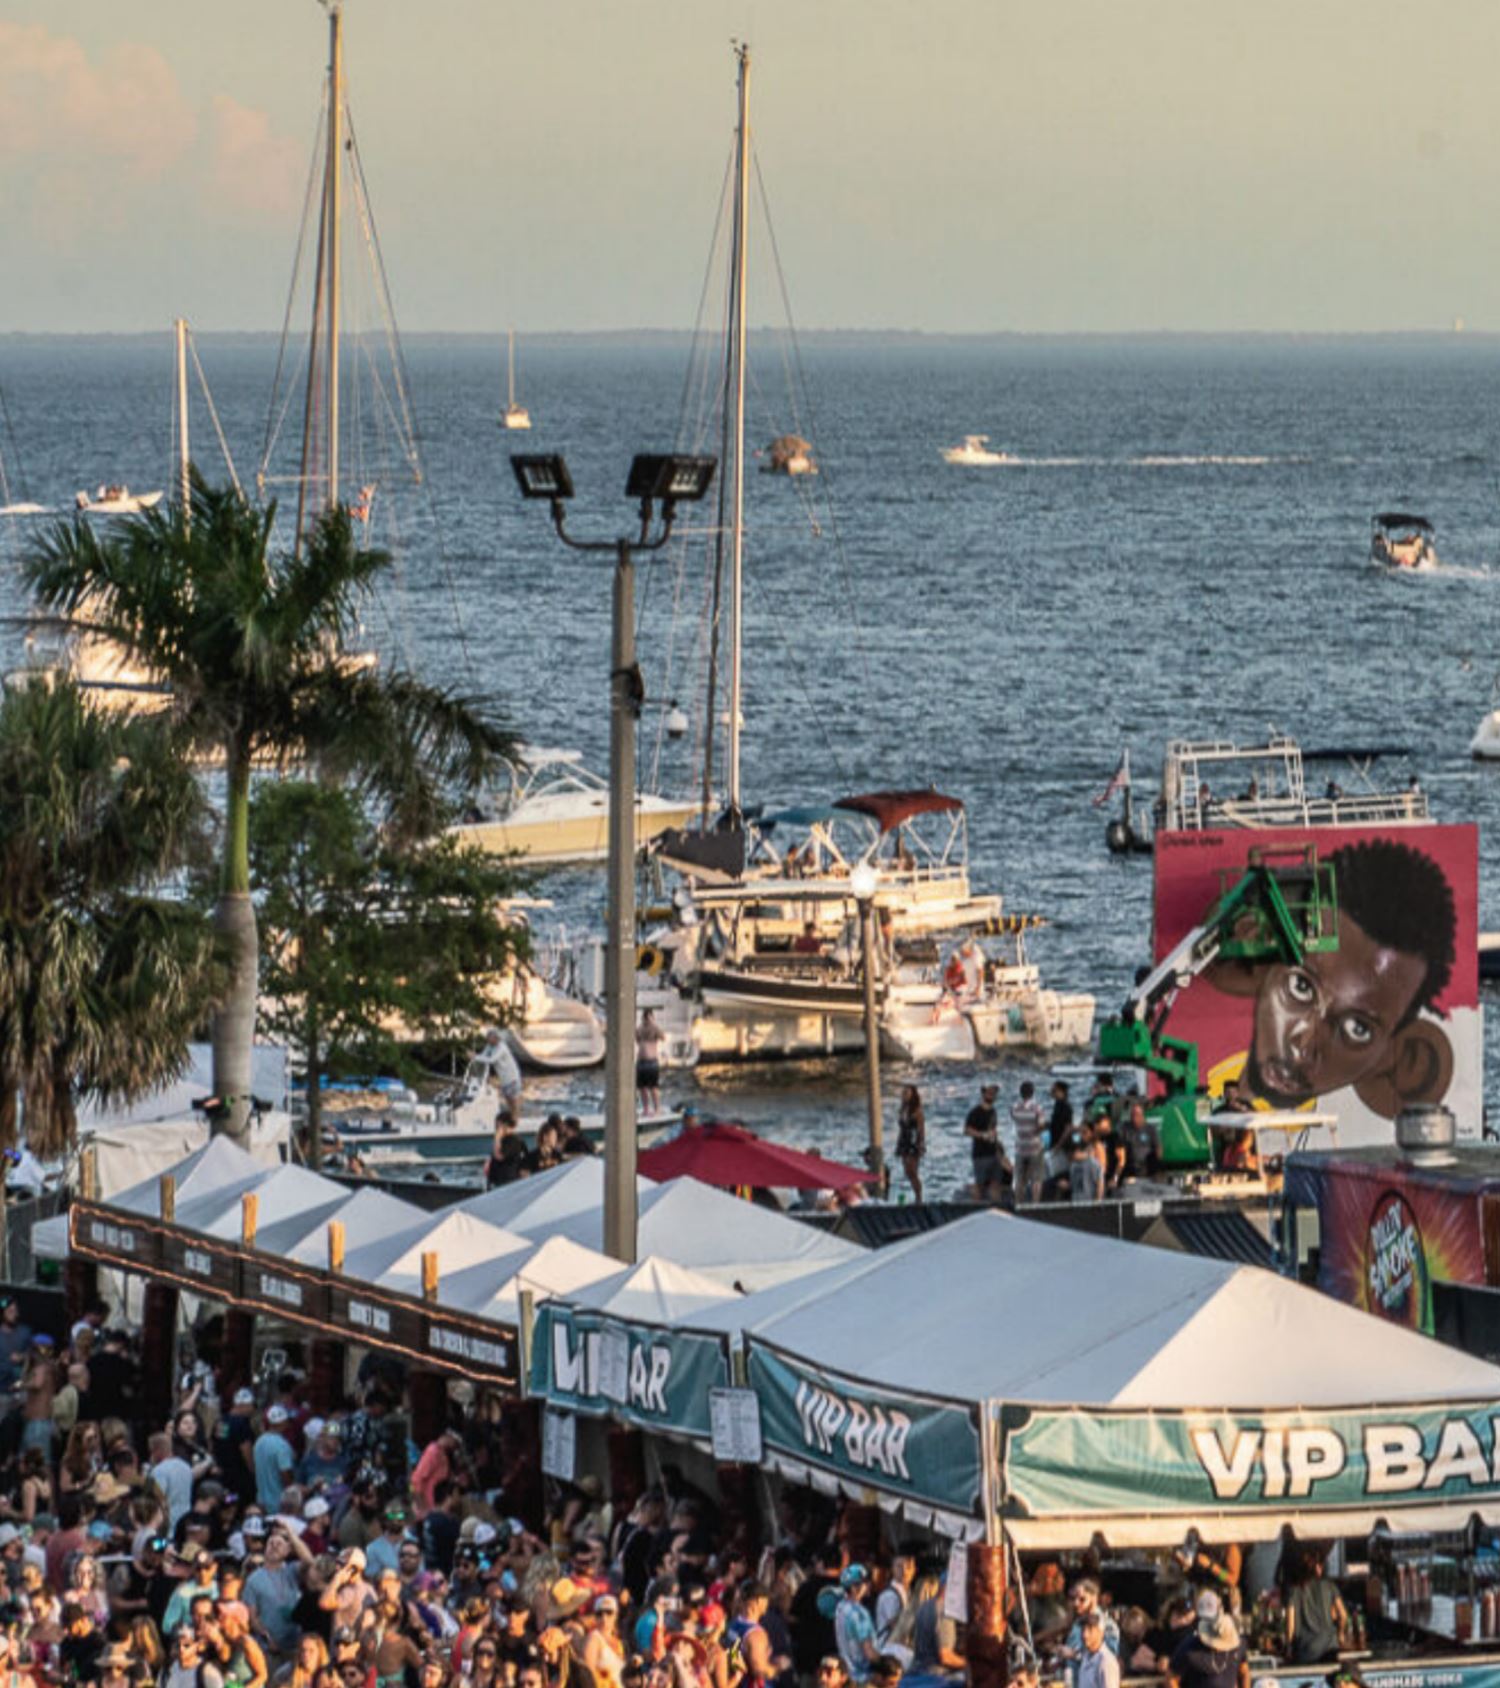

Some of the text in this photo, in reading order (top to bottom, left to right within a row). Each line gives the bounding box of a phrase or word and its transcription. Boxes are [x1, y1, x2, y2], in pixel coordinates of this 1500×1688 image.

[795, 1380, 846, 1454] VIP
[844, 1398, 911, 1480] BAR
[1191, 1426, 1346, 1498] VIP
